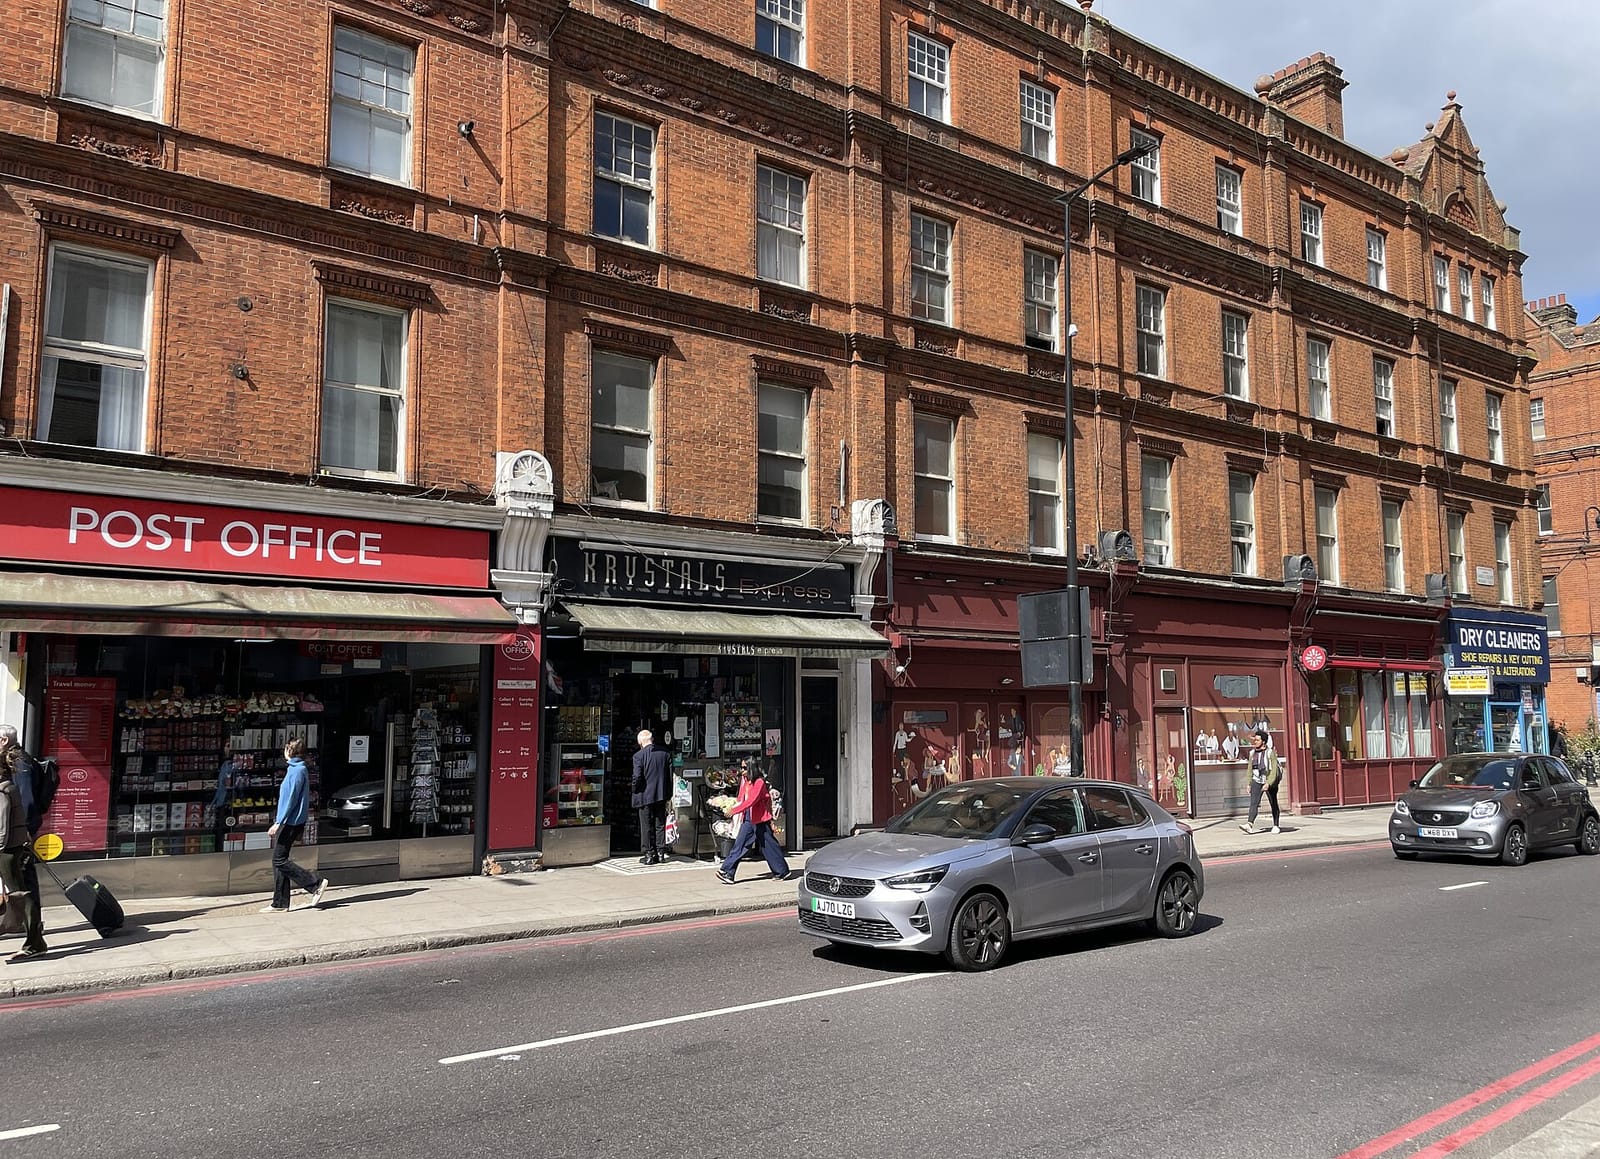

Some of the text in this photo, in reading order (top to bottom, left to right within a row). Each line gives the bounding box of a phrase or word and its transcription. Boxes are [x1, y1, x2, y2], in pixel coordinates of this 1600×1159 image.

[68, 507, 382, 566] POST OFFICE
[583, 551, 832, 600] KRYSTALS Express
[1460, 628, 1541, 651] DRY CLEANERS
[337, 644, 374, 654] OFFICE
[505, 646, 530, 654] OFFICE
[1461, 652, 1477, 662] SHOE
[1478, 653, 1502, 663] REPAIRS
[1503, 654, 1508, 664] &
[1509, 654, 1520, 664] KEY
[1521, 655, 1543, 665] CUTTING
[1496, 666, 1501, 676] &
[1503, 666, 1537, 676] ALTERATIONS
[817, 899, 853, 916] AJ70 LZG
